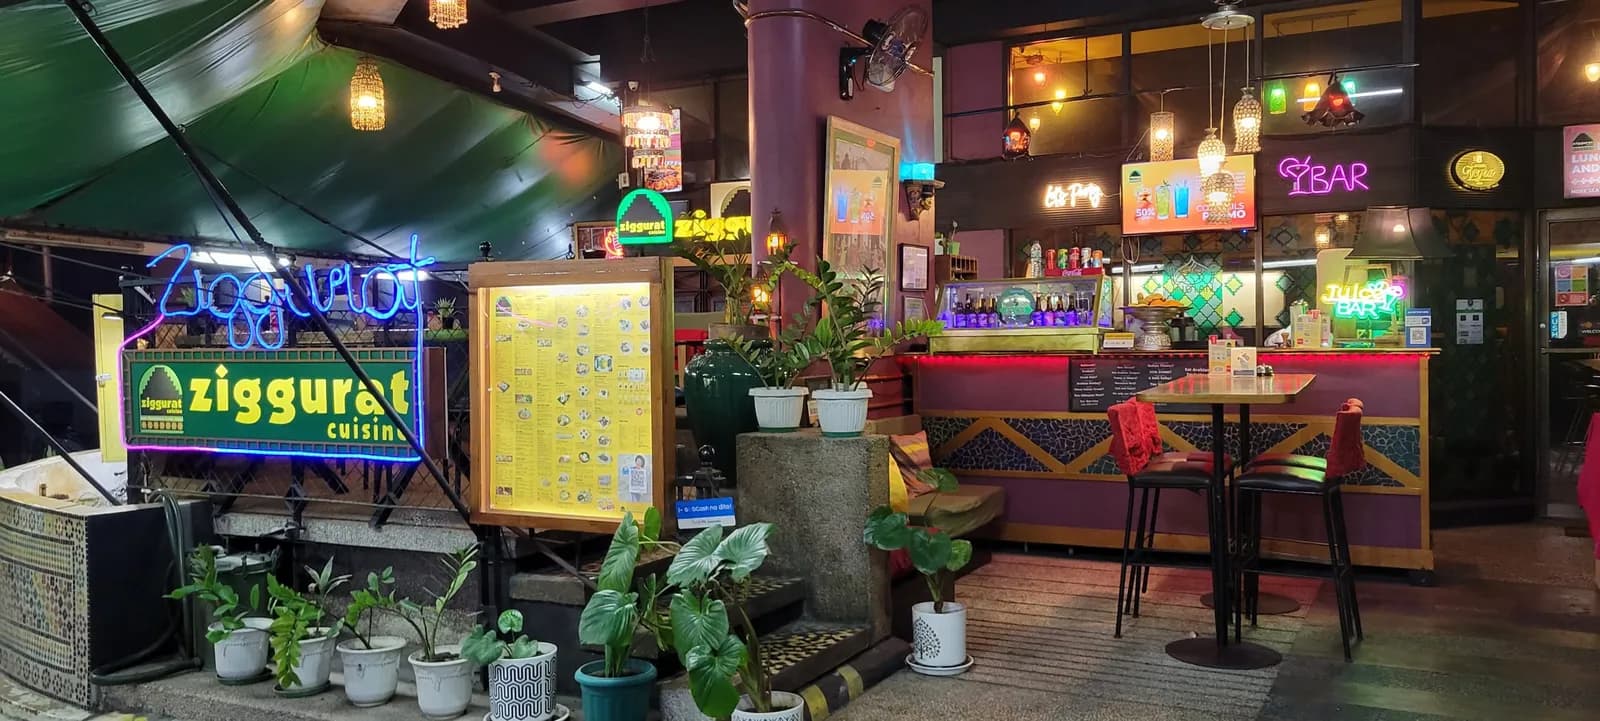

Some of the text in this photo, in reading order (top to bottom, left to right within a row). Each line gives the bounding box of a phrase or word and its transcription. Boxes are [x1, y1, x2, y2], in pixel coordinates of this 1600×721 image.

[1311, 163, 1369, 193] BAR
[1136, 208, 1156, 217] 50%
[619, 221, 665, 233] ziggurat
[1336, 300, 1379, 318] BAR
[189, 364, 410, 425] ziggurat
[141, 397, 182, 411] ziggurat
